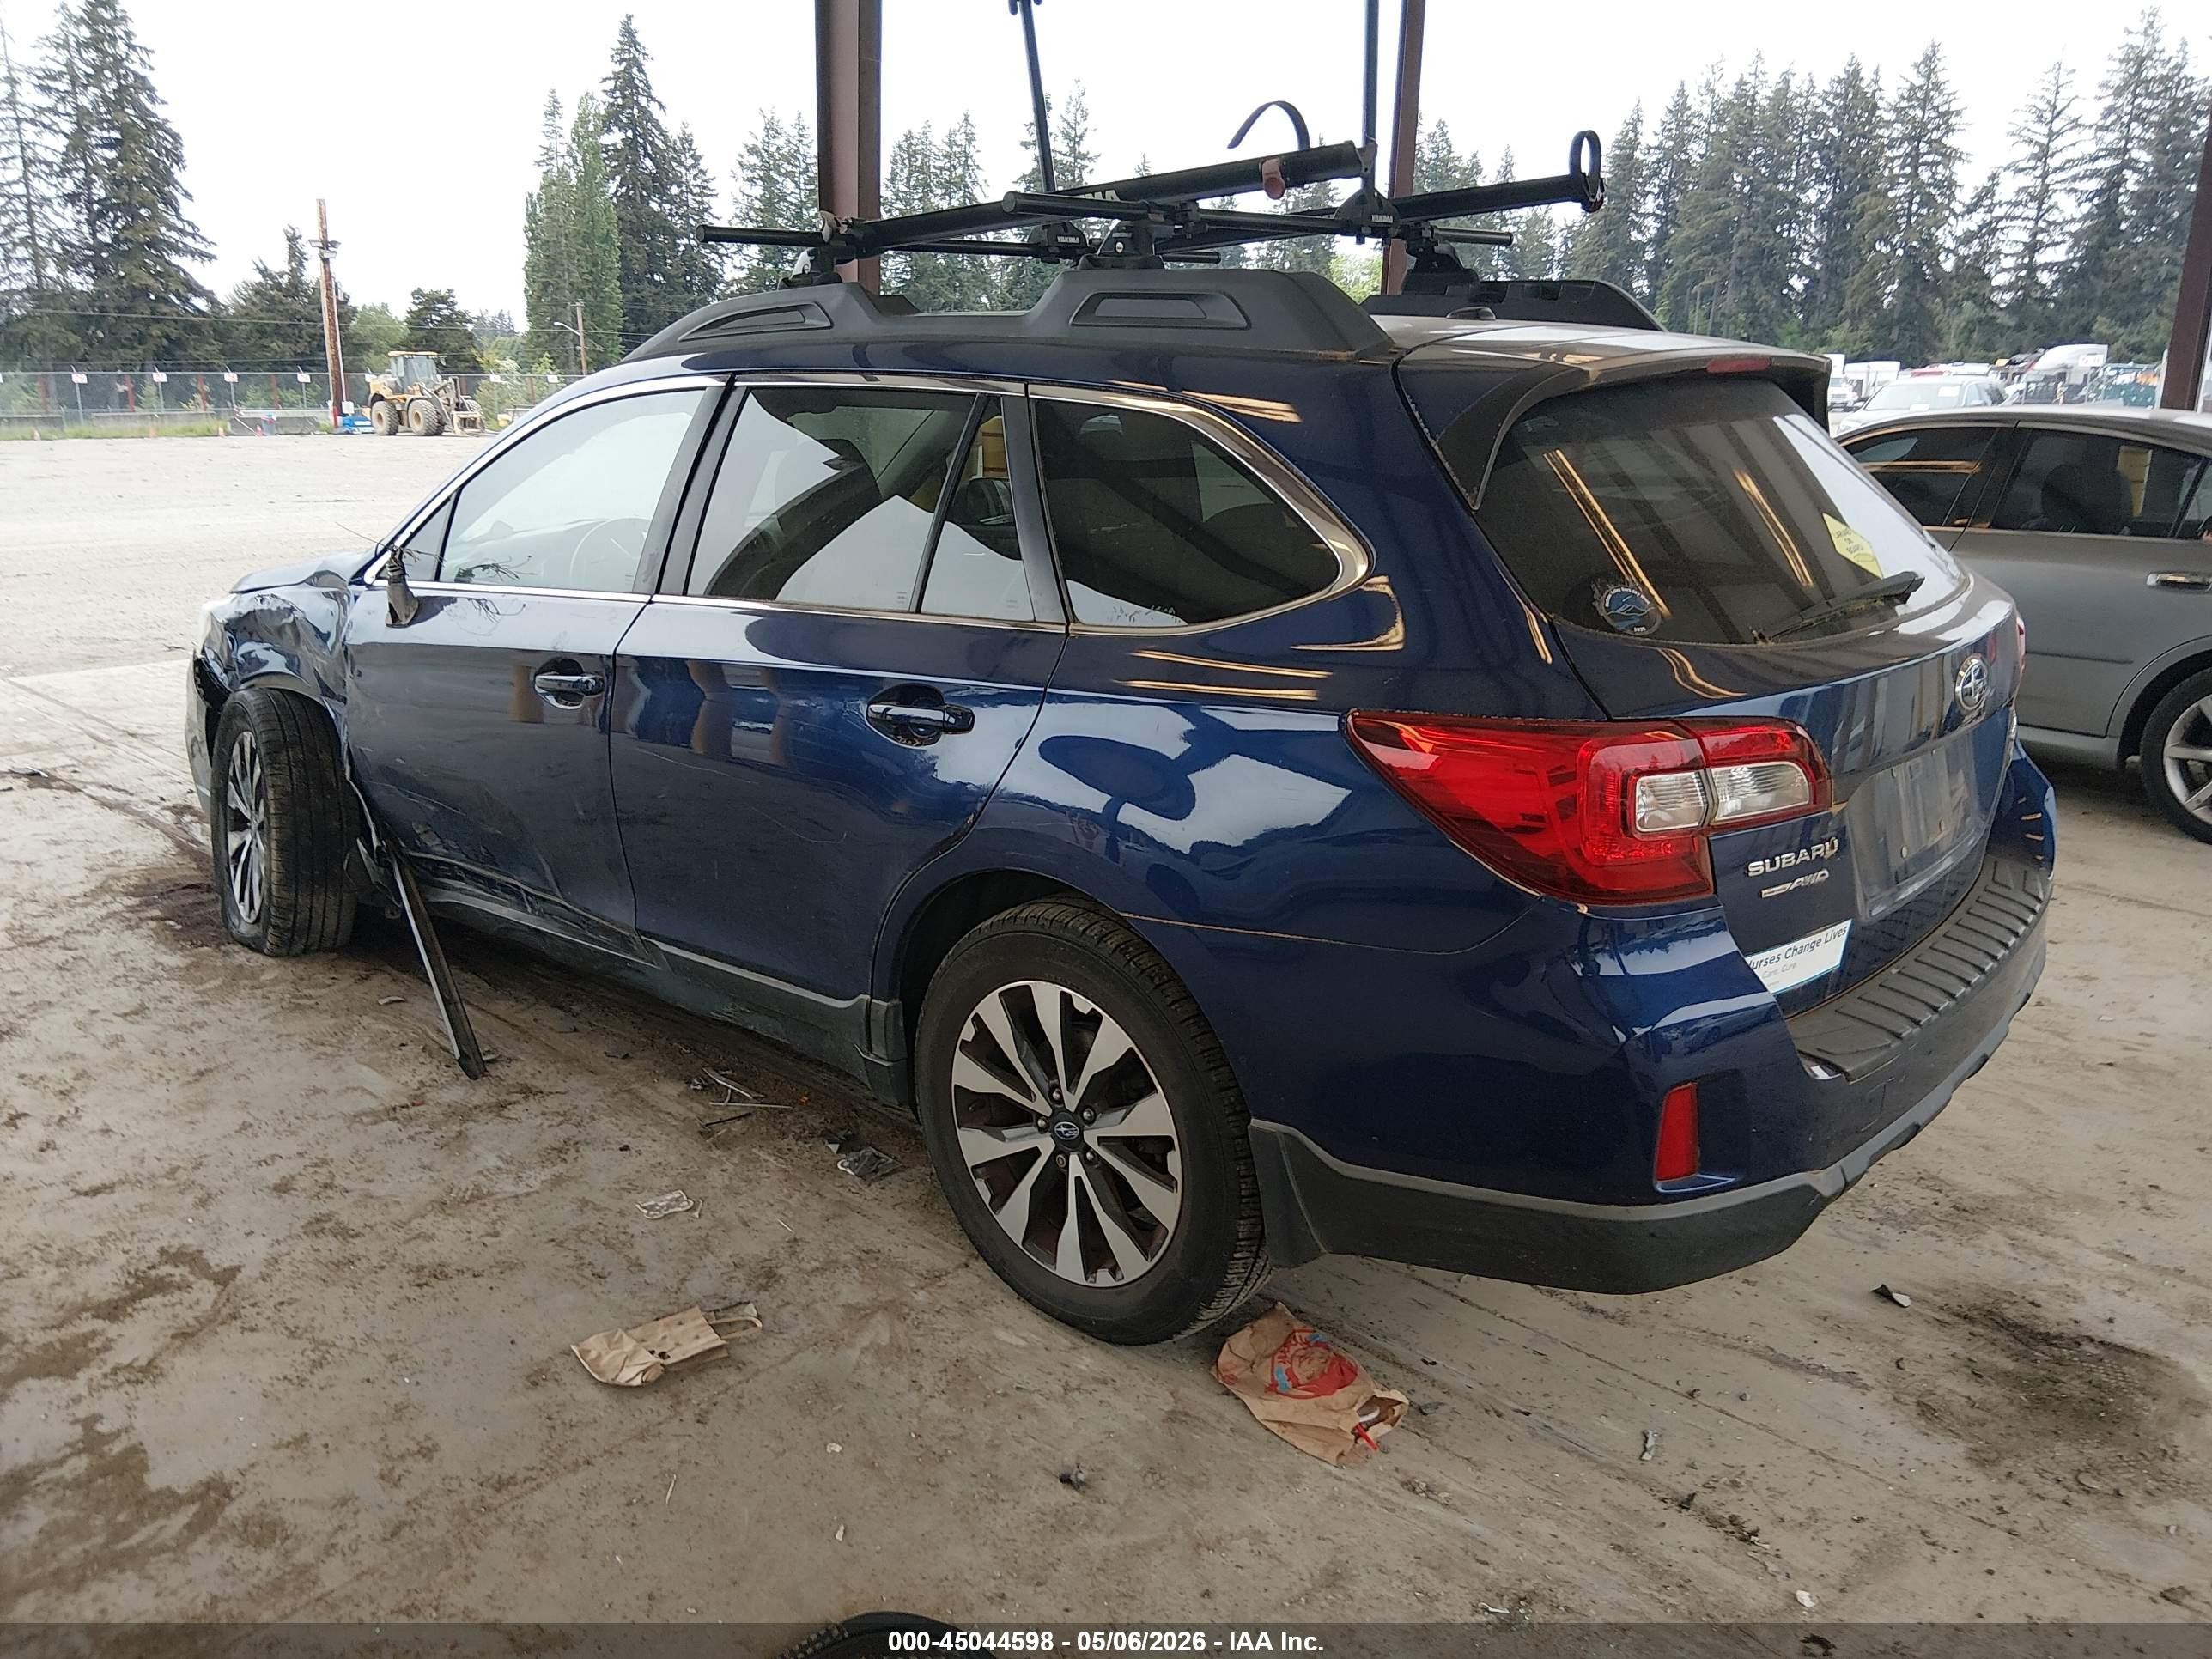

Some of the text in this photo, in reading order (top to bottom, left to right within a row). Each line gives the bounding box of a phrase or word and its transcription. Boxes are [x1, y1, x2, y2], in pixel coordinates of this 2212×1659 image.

[1747, 836, 1838, 877] SUBARU
[1788, 869, 1830, 890] AWD
[1784, 937, 1822, 960] Change
[1824, 926, 1848, 944] Lives
